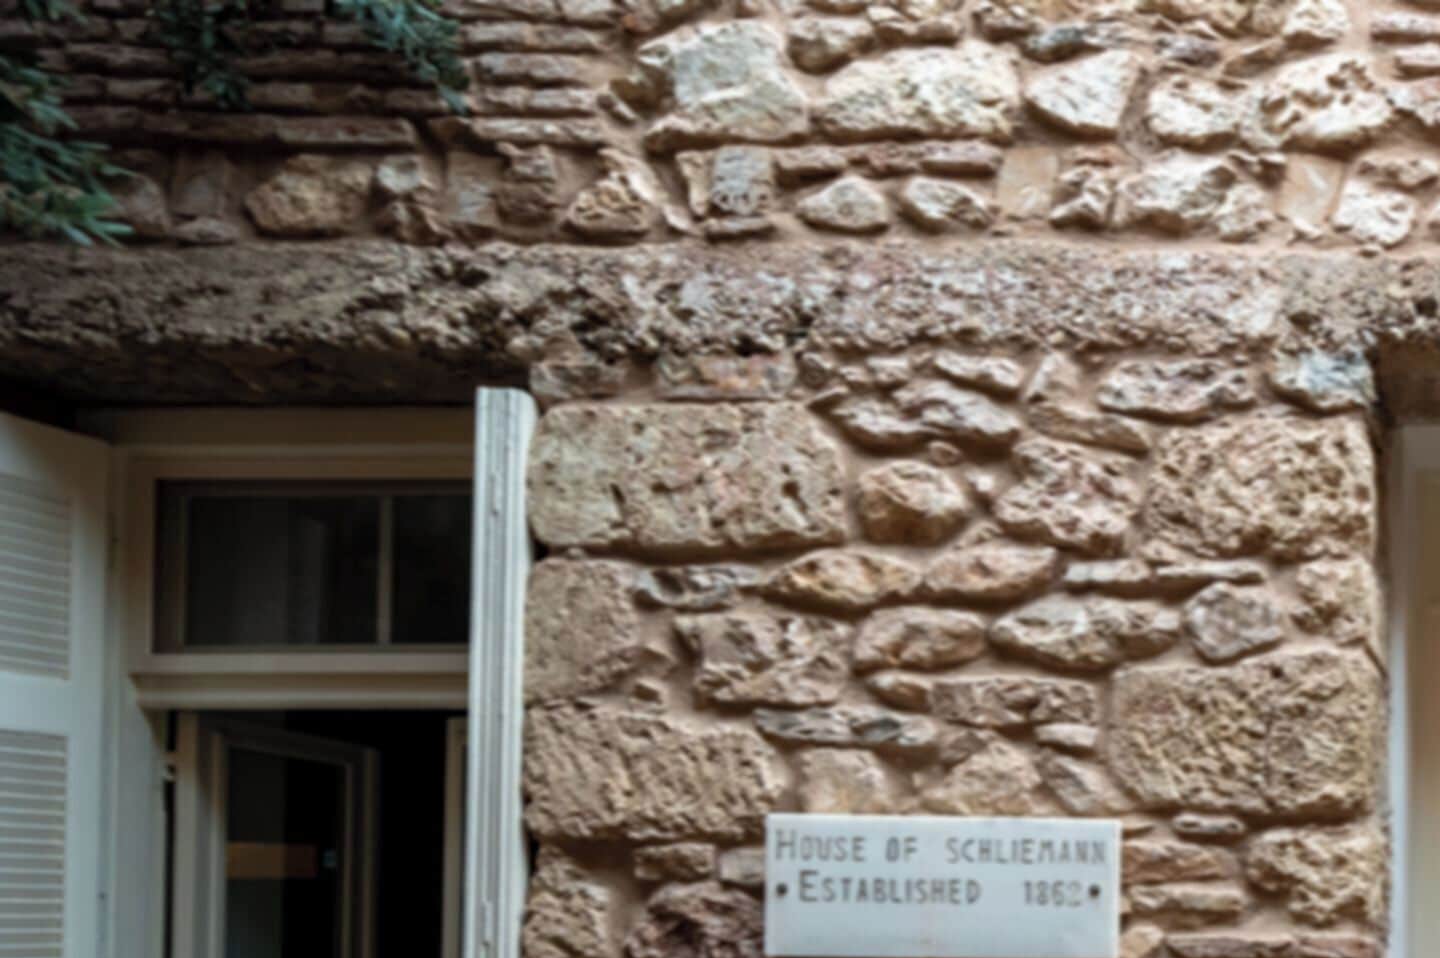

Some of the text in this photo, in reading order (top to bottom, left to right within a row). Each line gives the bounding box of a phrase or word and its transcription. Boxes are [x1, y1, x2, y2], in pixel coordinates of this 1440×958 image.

[774, 829, 1107, 865] HOUSE OF SCHLIEMANN
[798, 869, 982, 905] ESTABLISHED
